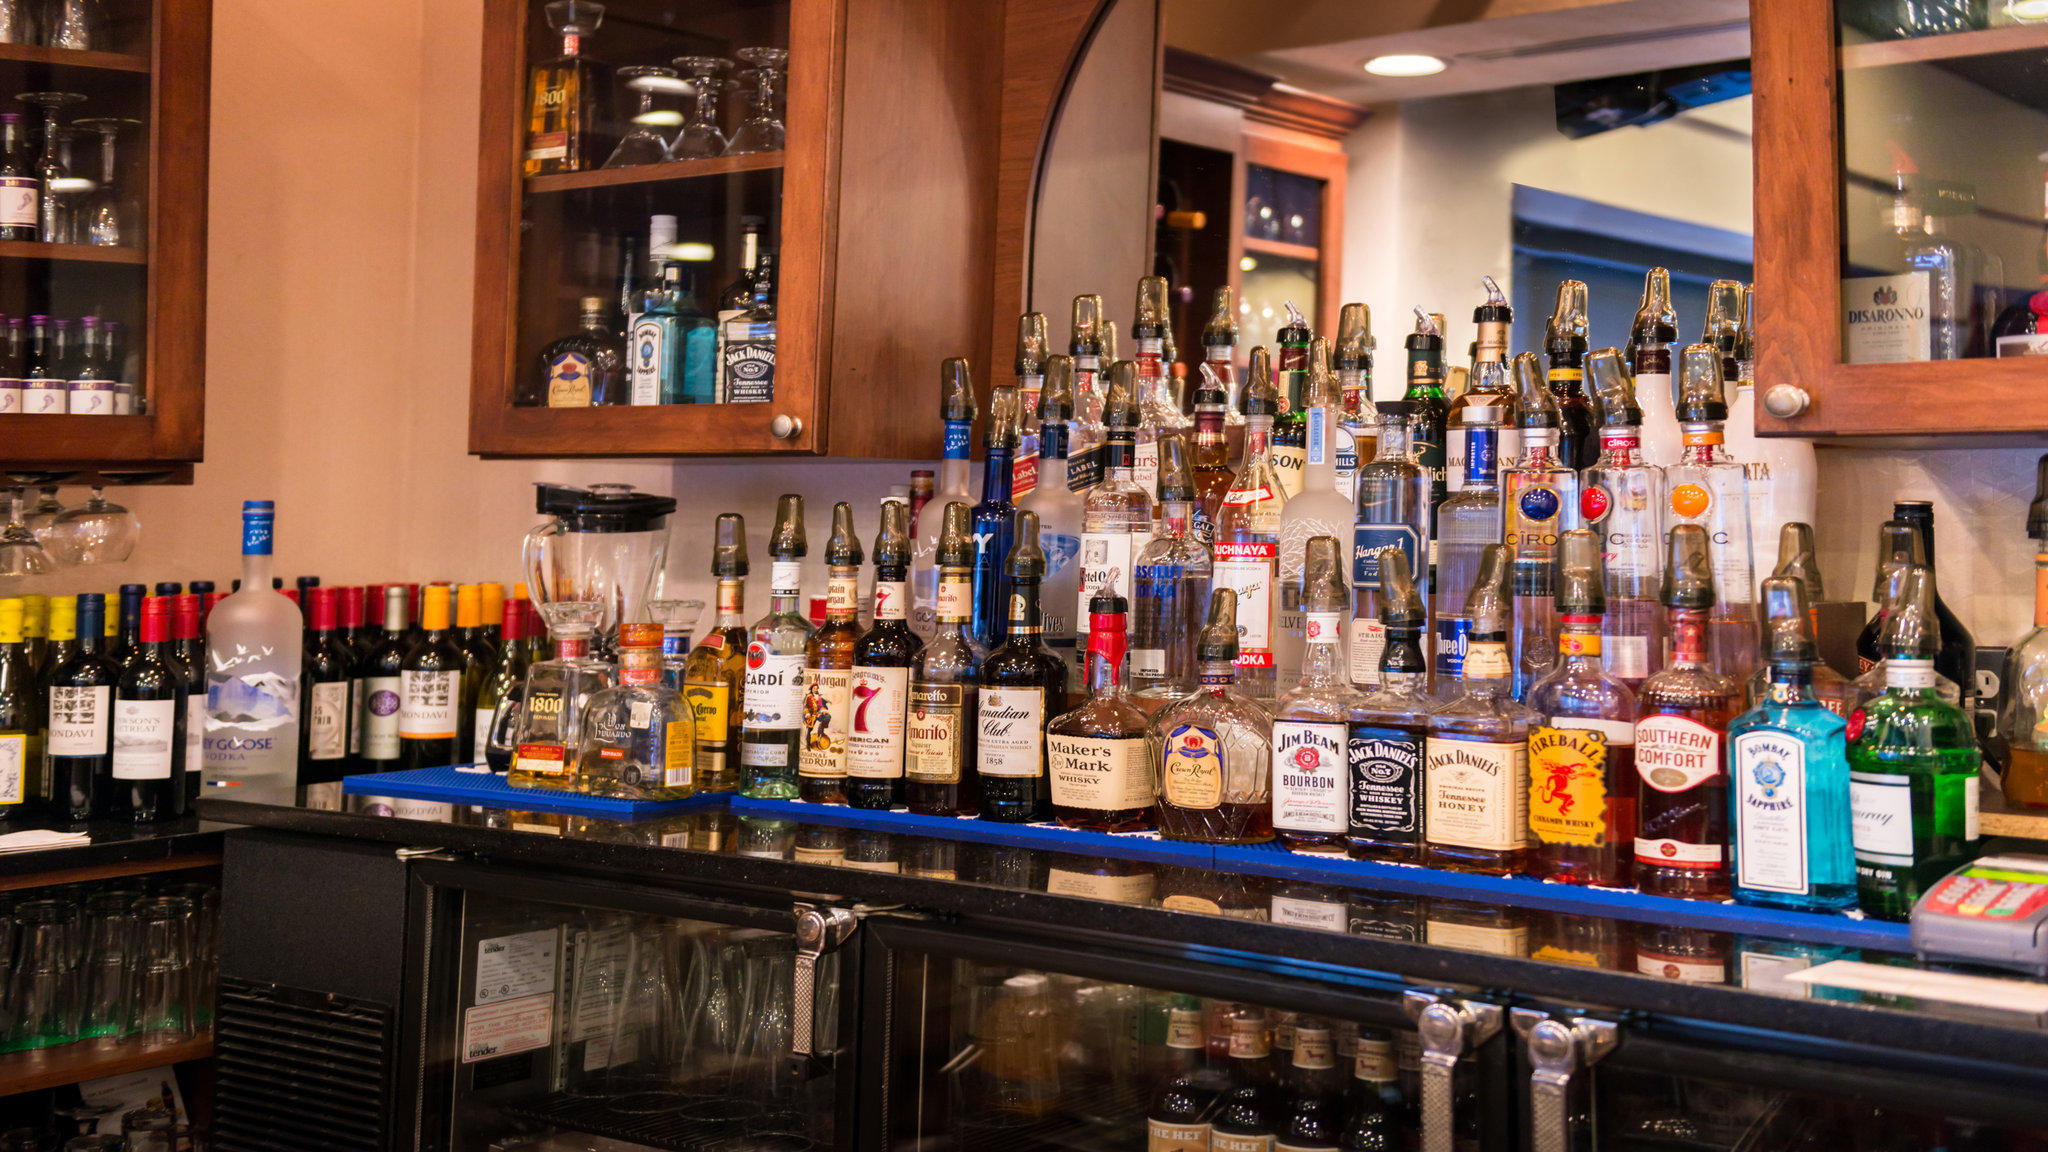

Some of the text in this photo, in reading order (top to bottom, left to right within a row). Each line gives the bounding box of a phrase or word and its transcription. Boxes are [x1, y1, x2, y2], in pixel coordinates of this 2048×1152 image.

[1849, 307, 1924, 324] DISARONNO
[726, 349, 746, 366] JACK
[973, 533, 994, 554] Y
[813, 673, 846, 688] Morgan
[529, 697, 563, 714] 1800
[852, 685, 882, 734] 7
[217, 737, 273, 751] GOOSE
[1278, 729, 1339, 756] JIM BEAM
[1531, 734, 1599, 761] FIREBALL
[1637, 729, 1713, 751] SOUTHERN
[1050, 741, 1111, 757] Maker's
[1348, 741, 1418, 769] JACK DANIEL'S
[1747, 742, 1792, 761] BOMBAY
[986, 757, 1003, 766] 1858
[1429, 749, 1502, 777] JACK DANIEL'S
[1638, 749, 1708, 768] COMFORT
[1059, 774, 1099, 785] WHISKY
[1283, 774, 1335, 789] BOURBON
[1358, 780, 1405, 794] Tennessee
[1359, 794, 1404, 805] WHISKEY
[1438, 789, 1486, 803] Tennessee
[1747, 793, 1793, 812] SAPPHIRE
[1438, 801, 1486, 813] HONEY
[1565, 819, 1595, 828] WHISKY
[469, 1045, 498, 1058] tender
